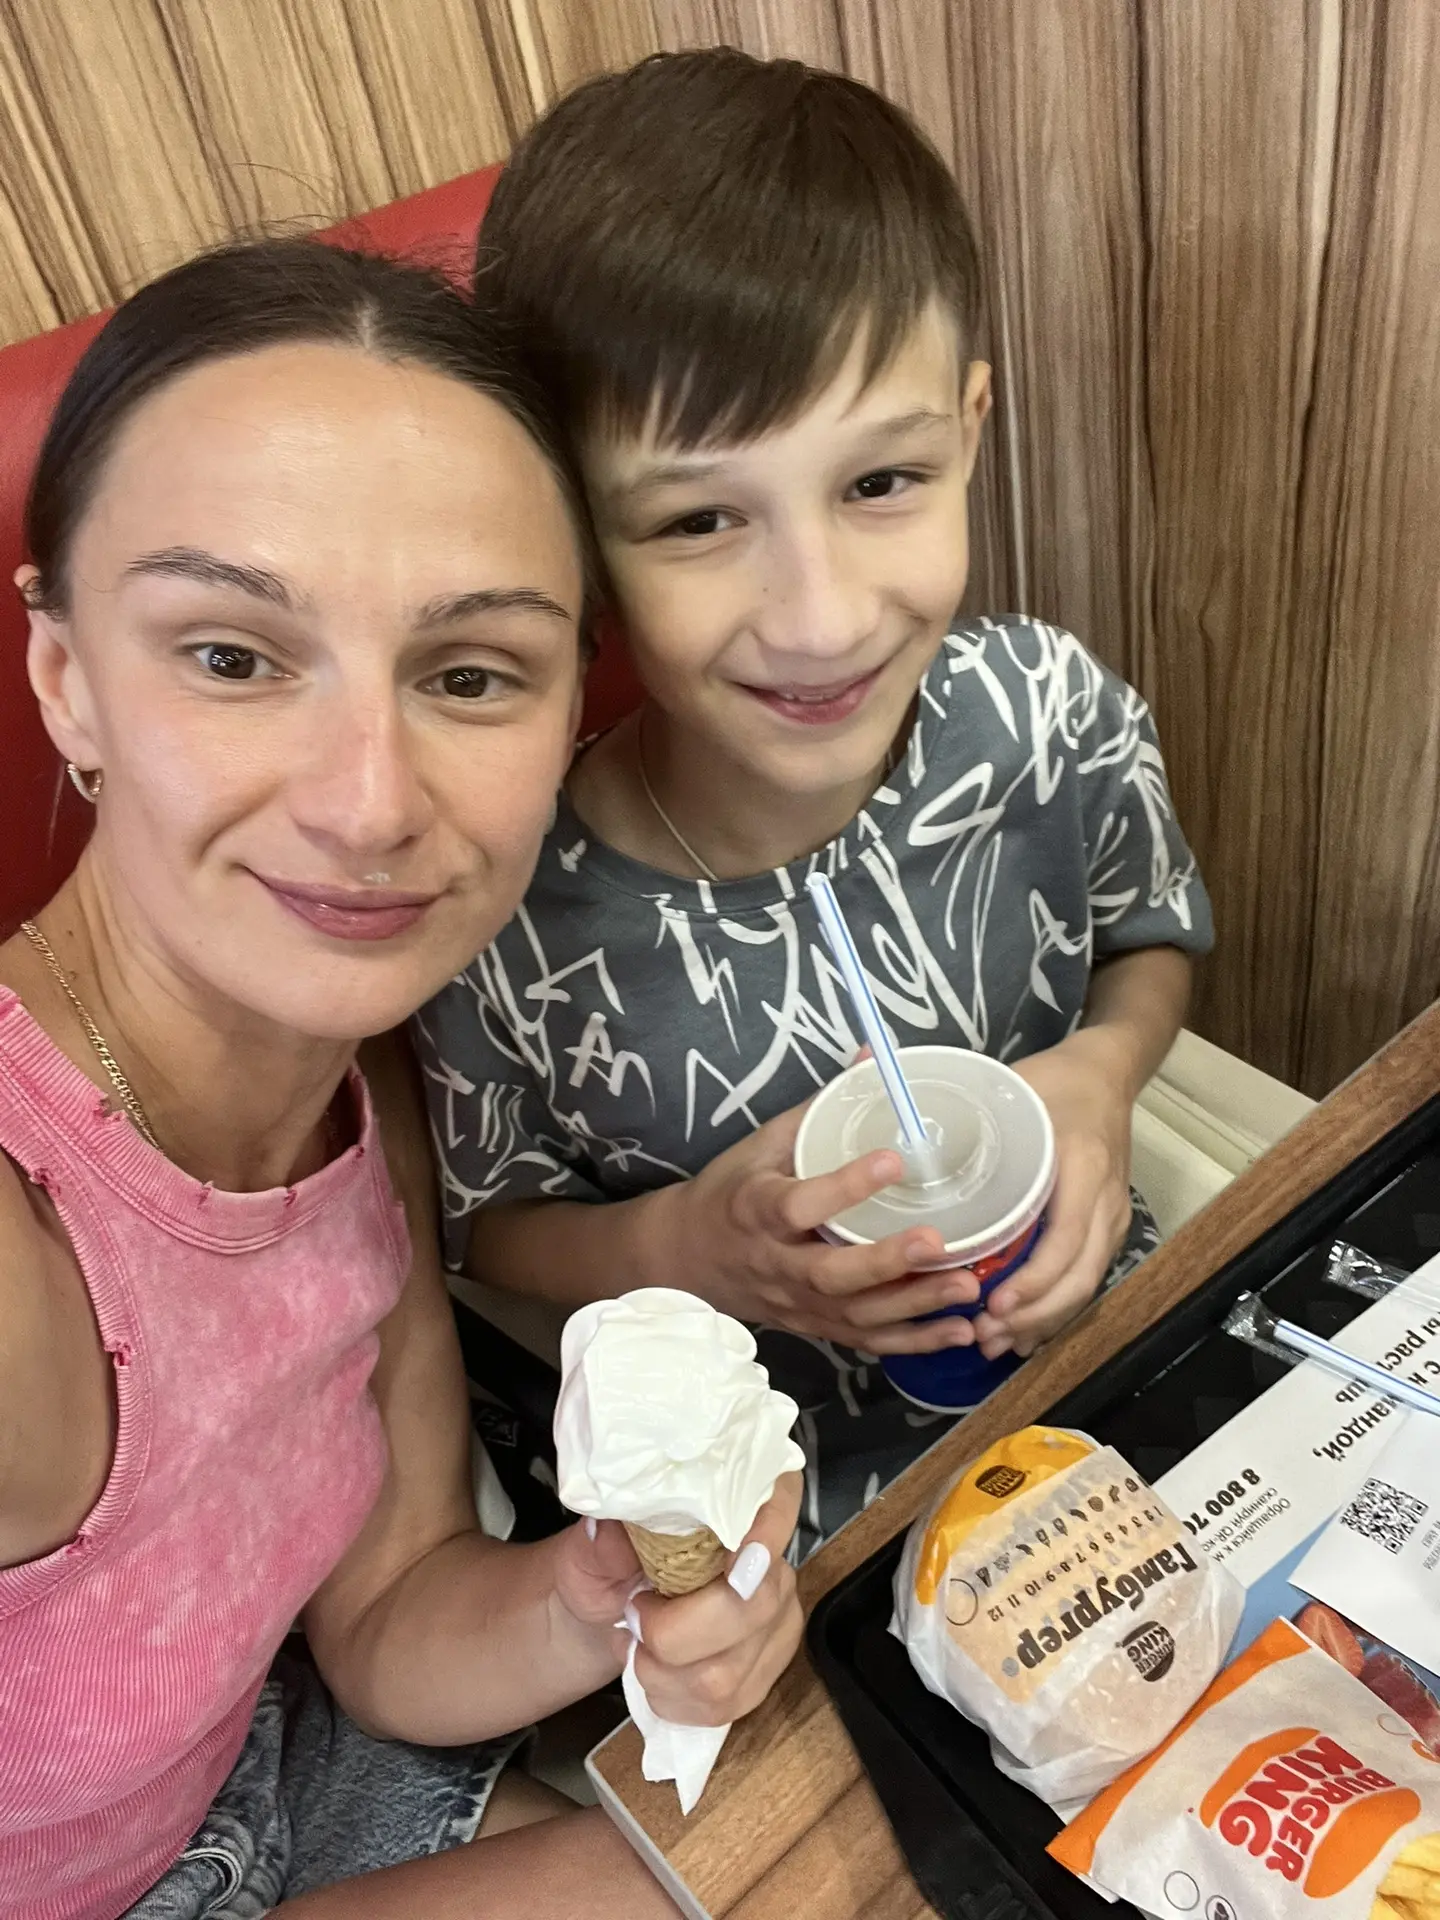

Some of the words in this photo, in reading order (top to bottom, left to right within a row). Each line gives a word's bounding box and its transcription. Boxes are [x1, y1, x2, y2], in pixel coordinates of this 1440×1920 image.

[1241, 1468, 1260, 1485] 8
[1205, 1480, 1246, 1516] 800
[1229, 1486, 1278, 1529] сканируй
[1117, 1523, 1129, 1536] 4
[1131, 1515, 1143, 1528] 3
[1231, 1497, 1291, 1548] Обращайся
[1089, 1541, 1100, 1553] 6
[1060, 1560, 1072, 1573] 8
[1075, 1551, 1087, 1564] 7
[1045, 1569, 1056, 1583] 9
[1024, 1579, 1042, 1597] 10
[1006, 1593, 1021, 1609] 11
[1016, 1541, 1198, 1669] Гамбургер
[987, 1604, 1005, 1622] 12
[1127, 1626, 1170, 1663] KING
[1219, 1735, 1365, 1857] KING
[1265, 1767, 1397, 1882] BURGER
